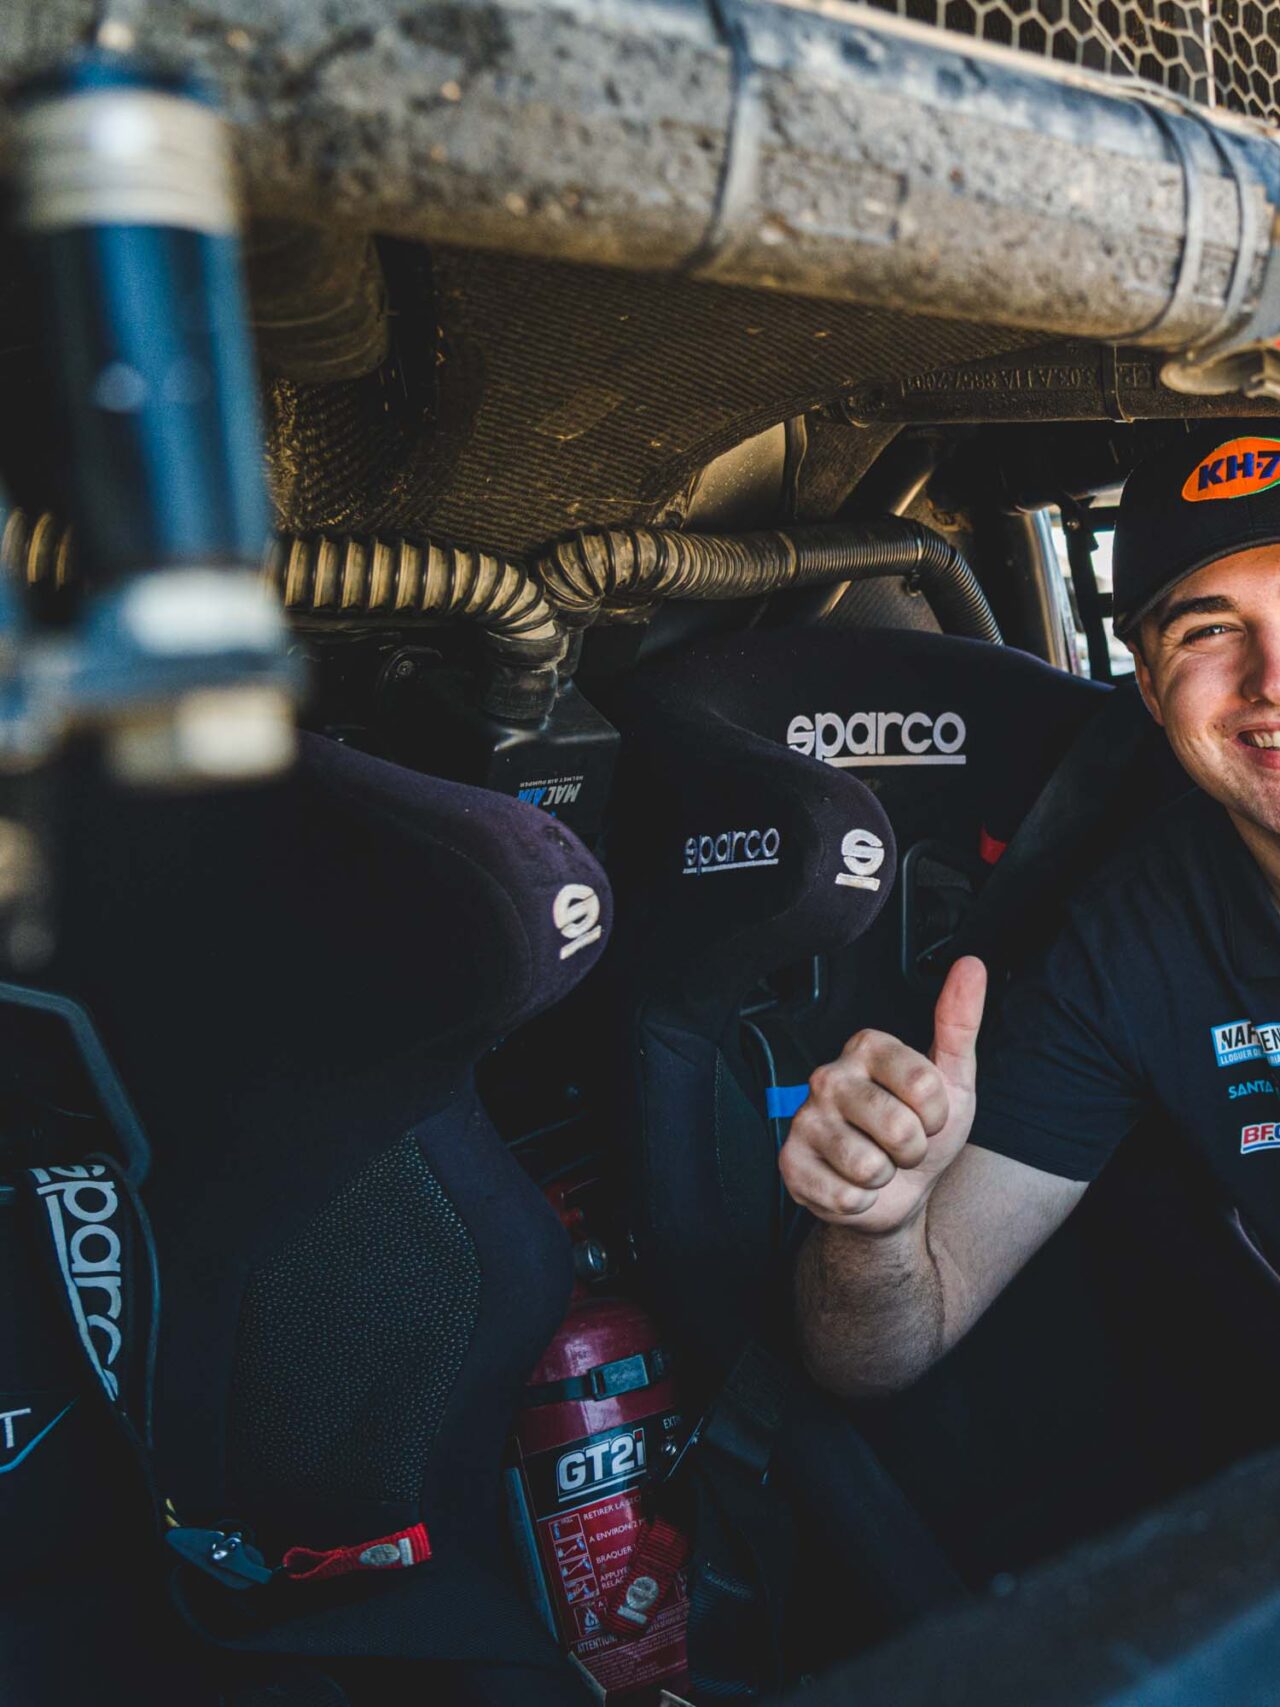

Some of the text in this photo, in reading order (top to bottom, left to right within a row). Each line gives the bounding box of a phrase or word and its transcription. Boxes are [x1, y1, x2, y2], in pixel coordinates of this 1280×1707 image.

[786, 710, 966, 763] sparco
[542, 782, 581, 806] MAC
[683, 827, 779, 873] sparco
[1228, 1078, 1274, 1100] SANTA
[557, 1430, 645, 1494] GT2i
[595, 1545, 633, 1564] BRAQUER
